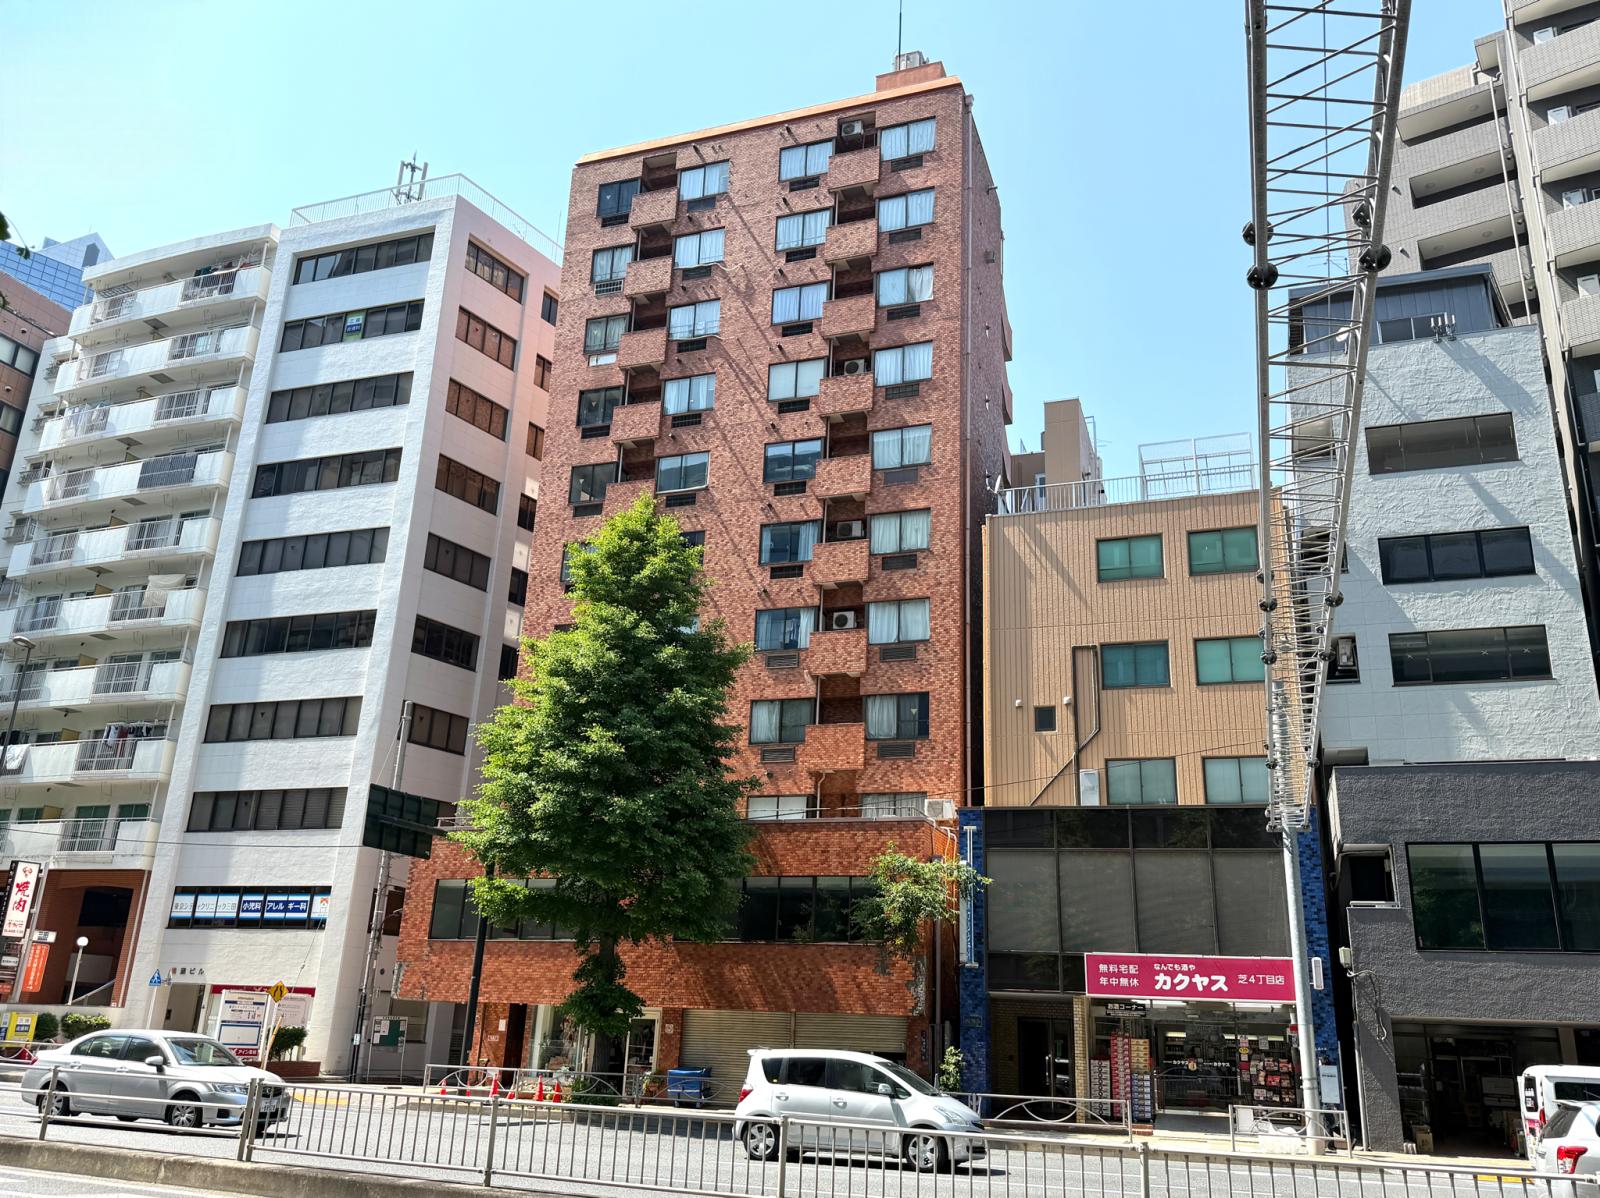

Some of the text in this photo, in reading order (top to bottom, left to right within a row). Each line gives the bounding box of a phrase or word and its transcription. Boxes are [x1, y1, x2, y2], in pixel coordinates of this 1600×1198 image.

[12, 881, 31, 913] 焼肉
[242, 901, 262, 911] 小児科
[266, 901, 307, 911] アレルギー科
[1098, 963, 1139, 975] 無料宅配
[1154, 963, 1196, 971] なんでも酒や
[1099, 976, 1140, 988] 年中無休
[1154, 972, 1229, 992] カクヤス
[1237, 974, 1285, 985] 芝4丁目店
